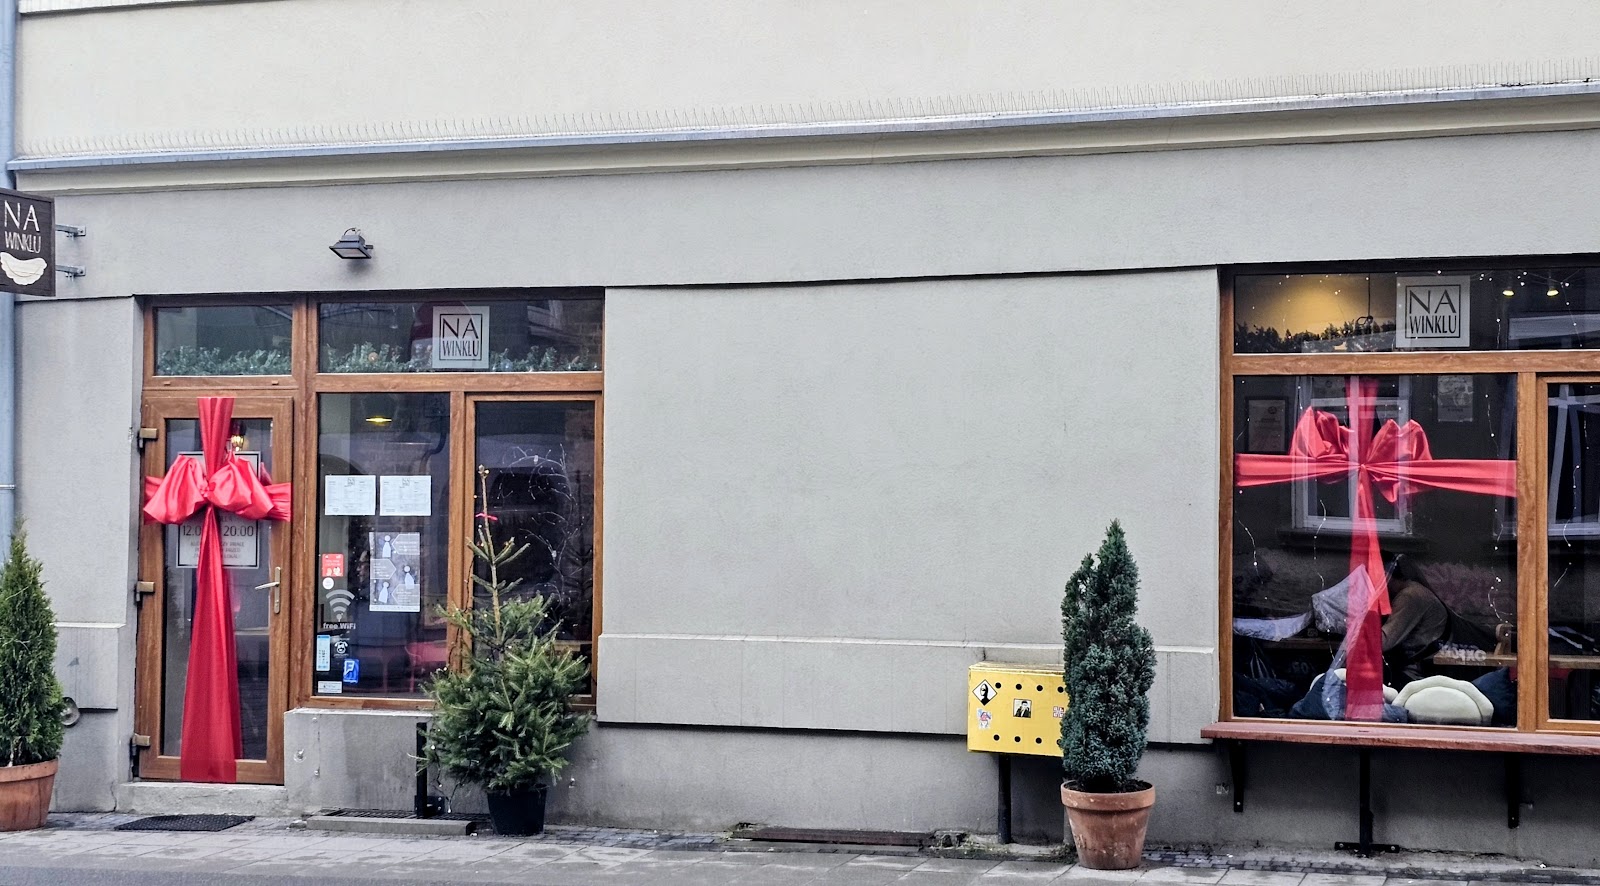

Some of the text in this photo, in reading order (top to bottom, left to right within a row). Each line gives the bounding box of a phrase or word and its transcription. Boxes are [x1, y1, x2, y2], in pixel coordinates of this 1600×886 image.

[4, 200, 40, 231] NA
[4, 231, 41, 253] WINKLU
[1409, 289, 1457, 314] NA
[442, 318, 479, 339] NA
[1409, 315, 1457, 334] WINKLU
[442, 340, 479, 356] WINKLU
